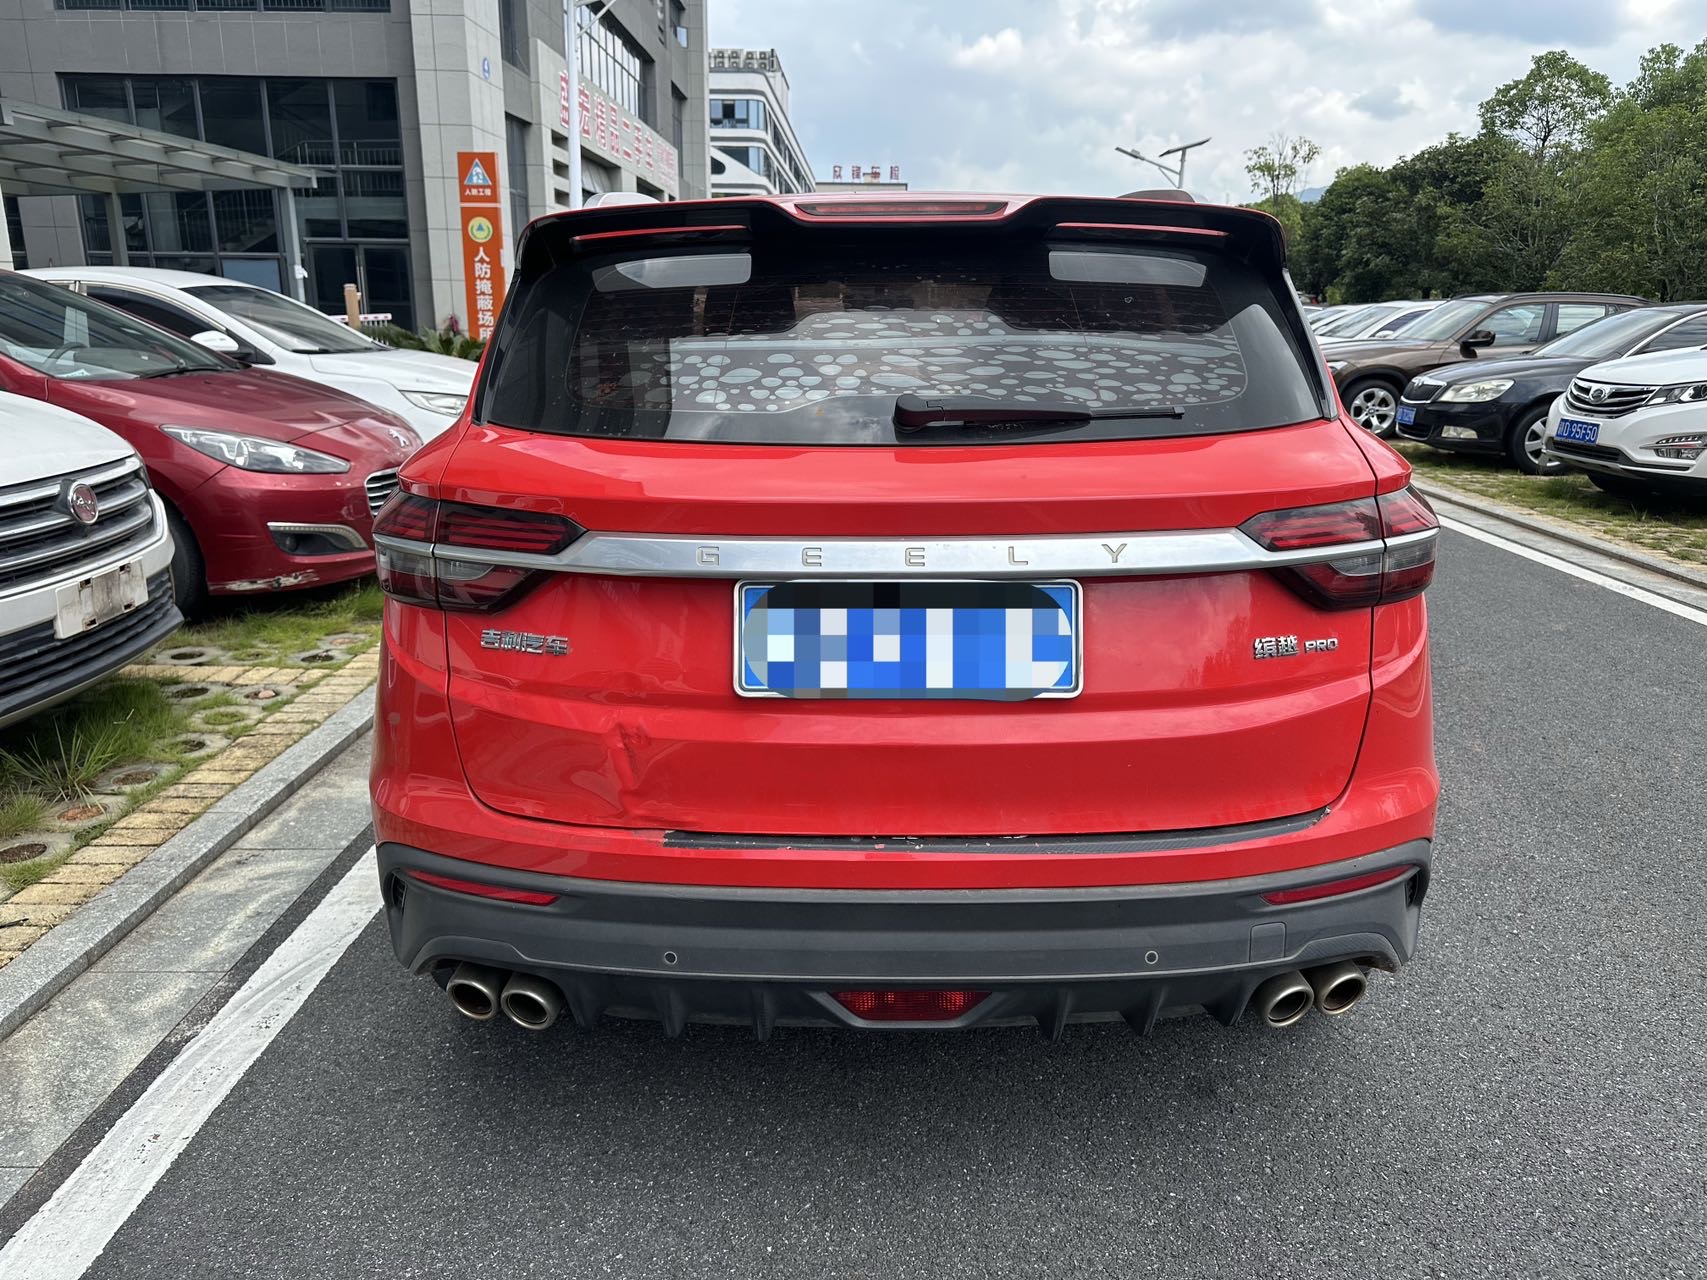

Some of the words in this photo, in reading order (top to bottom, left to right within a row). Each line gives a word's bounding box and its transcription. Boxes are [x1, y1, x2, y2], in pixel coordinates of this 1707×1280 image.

[464, 188, 492, 197] 人防工程
[696, 543, 1127, 567] GEELY
[480, 629, 569, 655] 吉利汽车
[1253, 635, 1299, 659] 缤越
[1304, 637, 1339, 652] PRO
